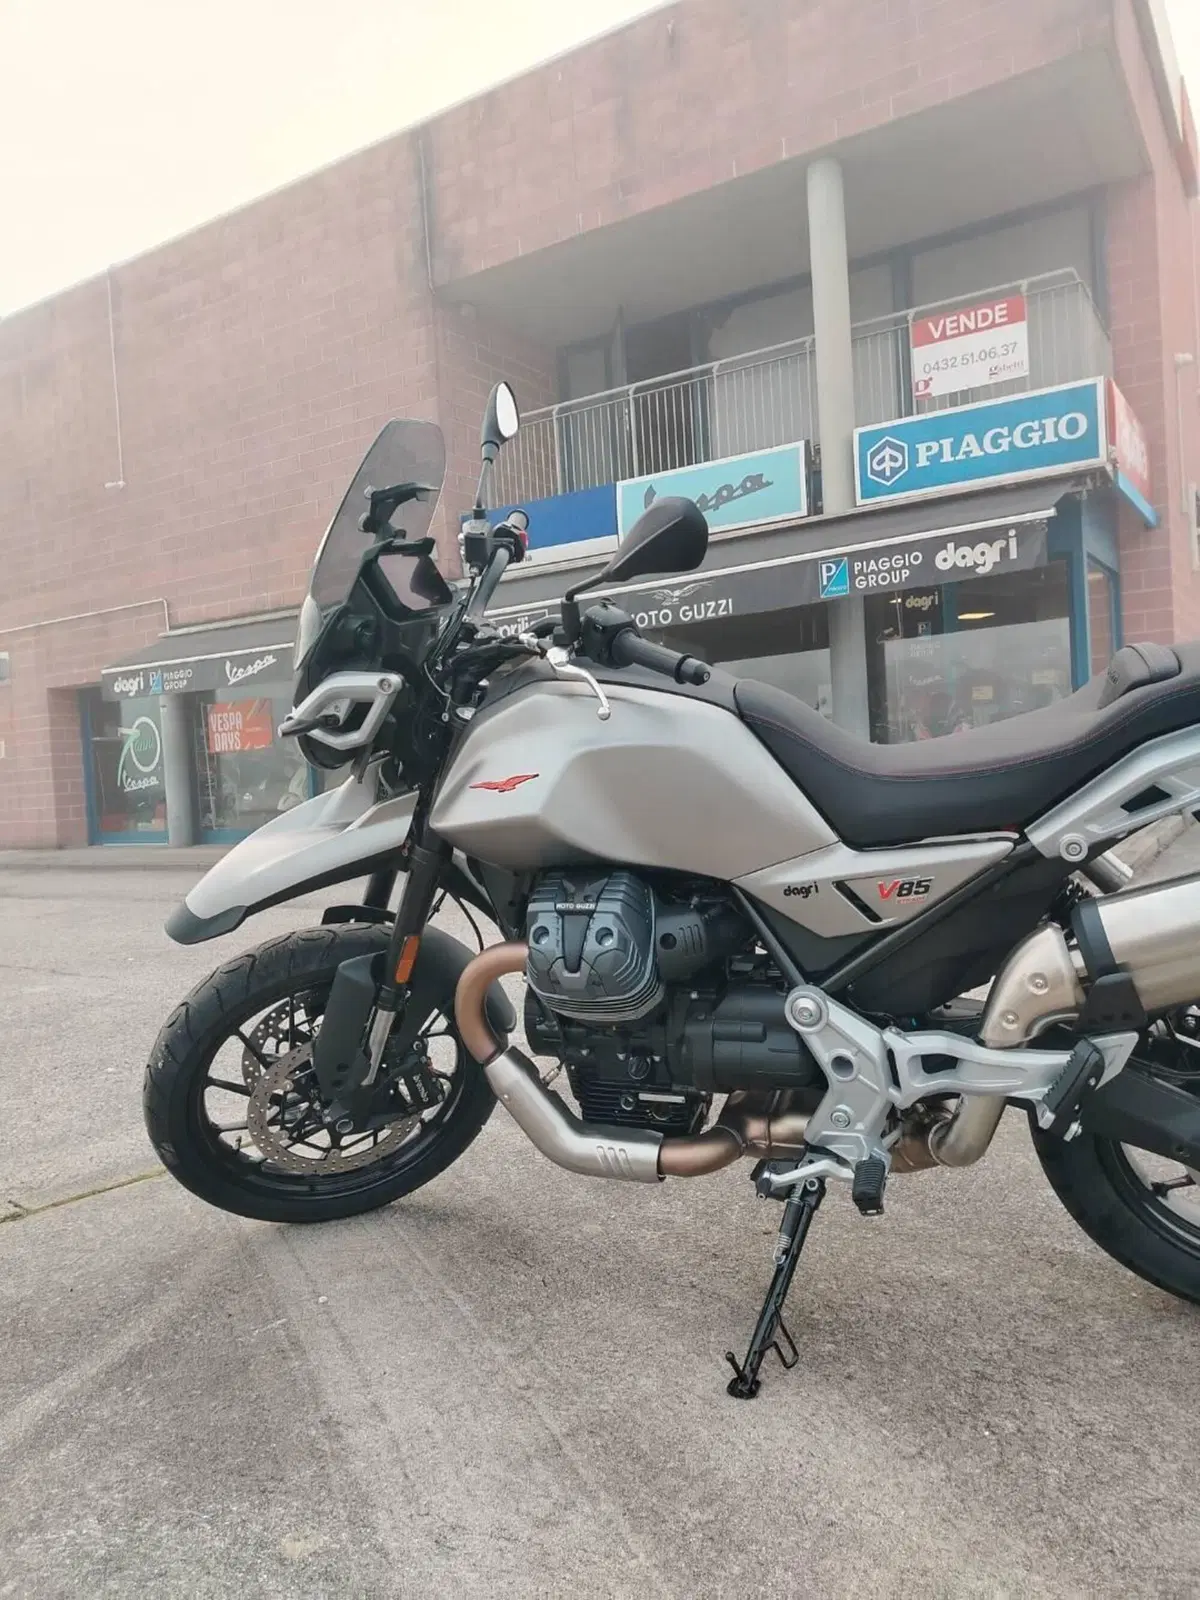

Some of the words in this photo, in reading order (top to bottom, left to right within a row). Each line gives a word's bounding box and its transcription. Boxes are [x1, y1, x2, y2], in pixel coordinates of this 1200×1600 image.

[928, 303, 1008, 339] VENDE
[915, 412, 1088, 468] PIAGGIO
[854, 551, 922, 574] PIAGGIO
[935, 529, 1018, 574] dagri
[855, 569, 910, 589] GROUP
[630, 608, 672, 628] OTO
[679, 598, 733, 621] GUZZI
[225, 655, 277, 686] Vespa
[113, 671, 144, 697] dagri
[210, 711, 243, 732] VESPA
[214, 731, 242, 752] DAYS
[122, 769, 160, 792] Vespa
[783, 882, 819, 899] dagri
[877, 876, 934, 902] V85
